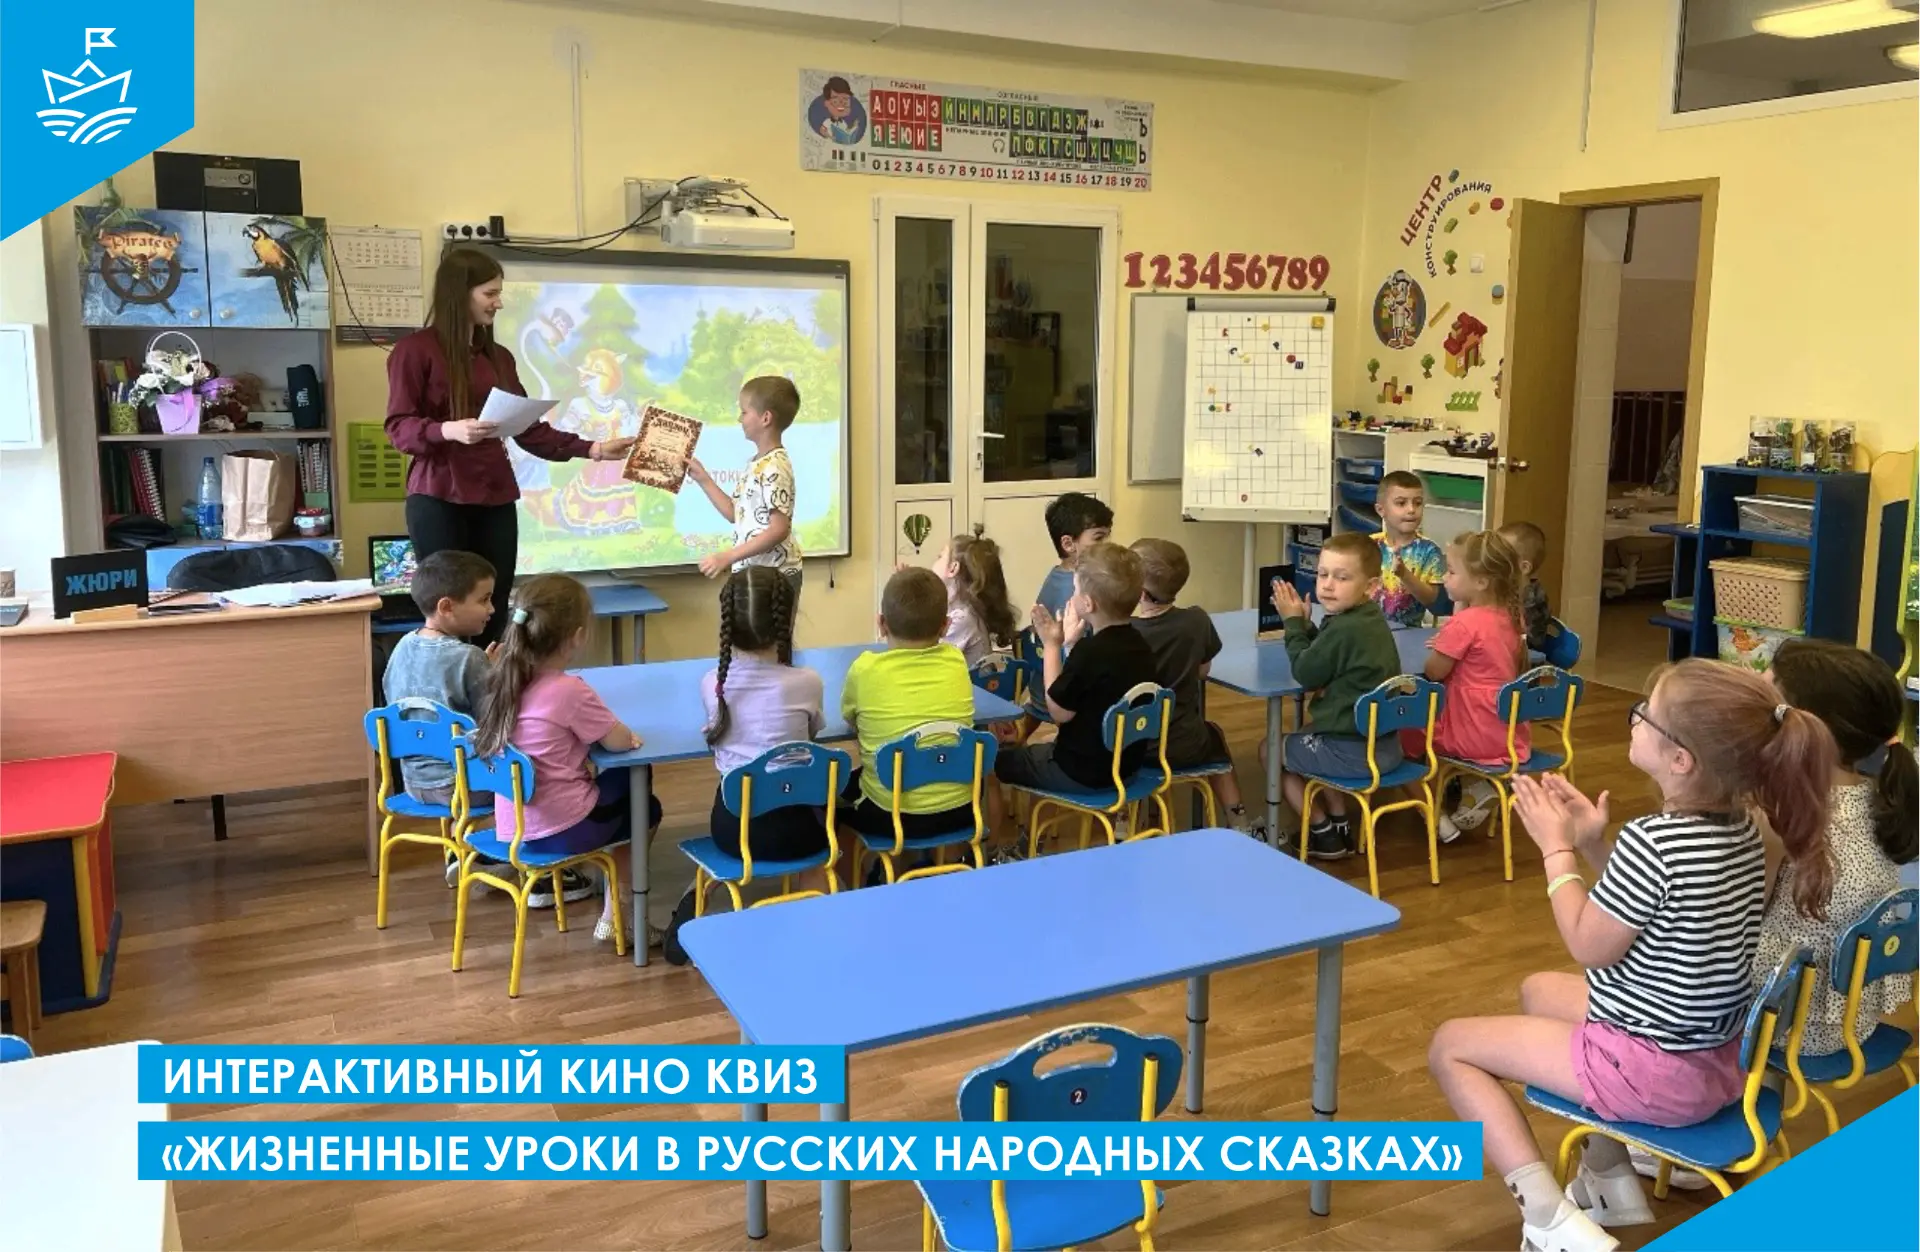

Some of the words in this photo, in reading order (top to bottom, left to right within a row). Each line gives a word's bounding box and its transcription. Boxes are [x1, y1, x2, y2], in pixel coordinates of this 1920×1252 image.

[872, 160, 880, 170] 0
[884, 161, 890, 171] 1
[894, 162, 902, 172] 2
[905, 162, 912, 172] 3
[916, 162, 924, 173] 4
[928, 163, 935, 174] 5
[938, 164, 945, 175] 6
[949, 165, 956, 176] 7
[959, 166, 966, 176] 8
[970, 166, 977, 177] 9
[980, 168, 993, 178] 10
[1012, 169, 1024, 180] 12
[1028, 170, 1040, 181] 13
[1044, 172, 1056, 182] 14
[1060, 173, 1072, 183] 15
[1076, 174, 1087, 184] 16
[1091, 175, 1103, 185] 17
[1105, 175, 1117, 186] 18
[1120, 176, 1132, 187] 19
[1135, 178, 1147, 188] 20
[1400, 174, 1442, 247] ЦЕНТР
[1425, 181, 1492, 278] КОНСТРУИРОВАНИЯ
[66, 569, 138, 596] ЖЮРИ
[1074, 1090, 1083, 1104] 2
